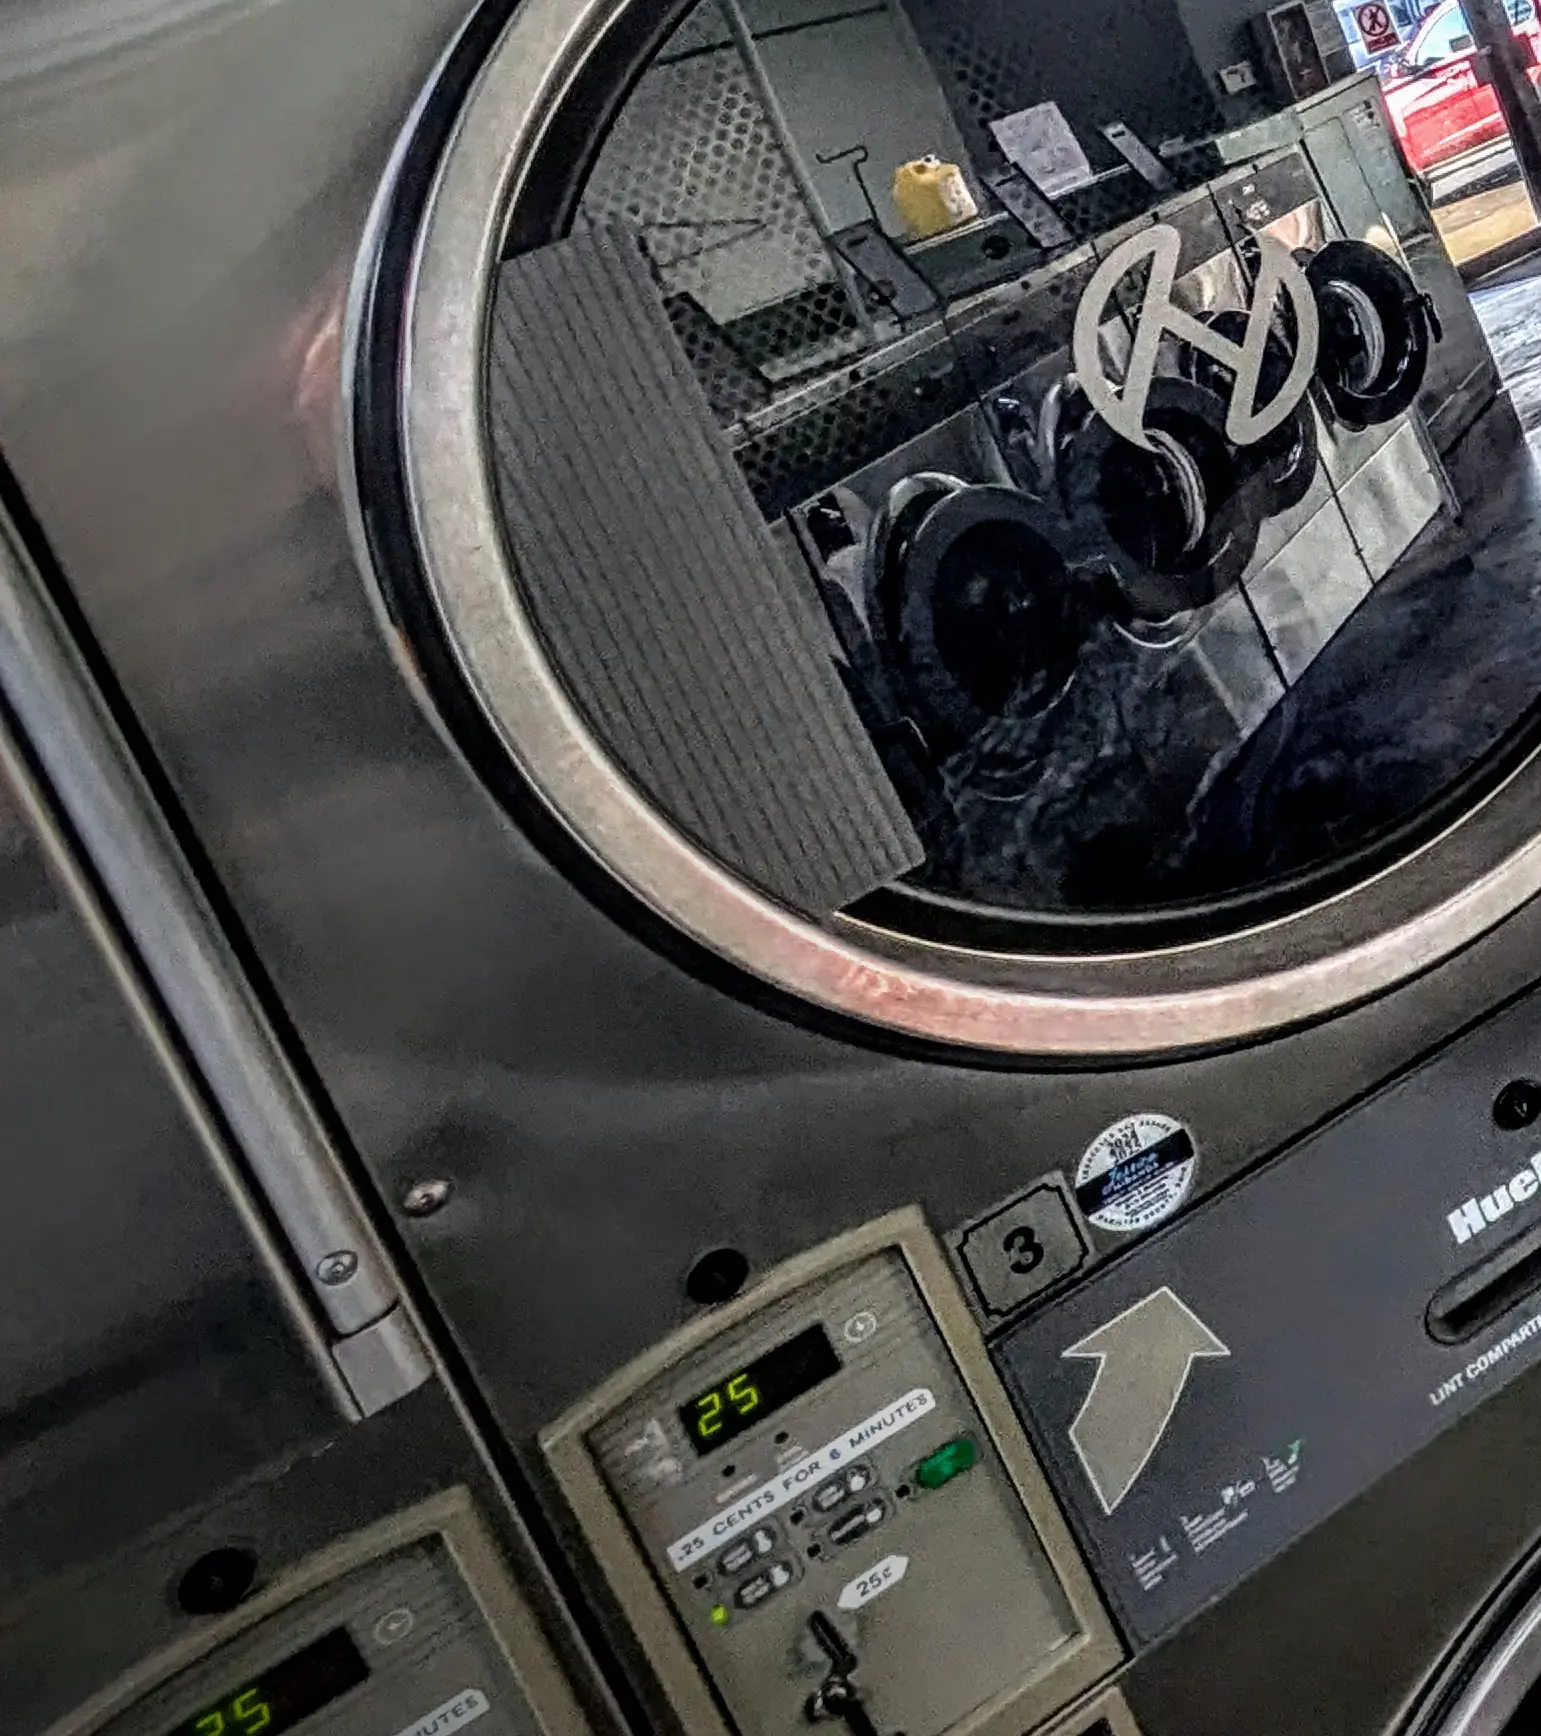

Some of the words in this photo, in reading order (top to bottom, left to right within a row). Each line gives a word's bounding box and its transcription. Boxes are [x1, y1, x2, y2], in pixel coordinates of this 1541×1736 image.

[1003, 1225, 1045, 1275] 3
[696, 1372, 760, 1438] 25
[1429, 1375, 1465, 1406] LINT
[712, 1490, 776, 1537] CENTS
[781, 1460, 822, 1491] FOR
[829, 1448, 841, 1461] 6
[848, 1393, 929, 1449] MINUTES
